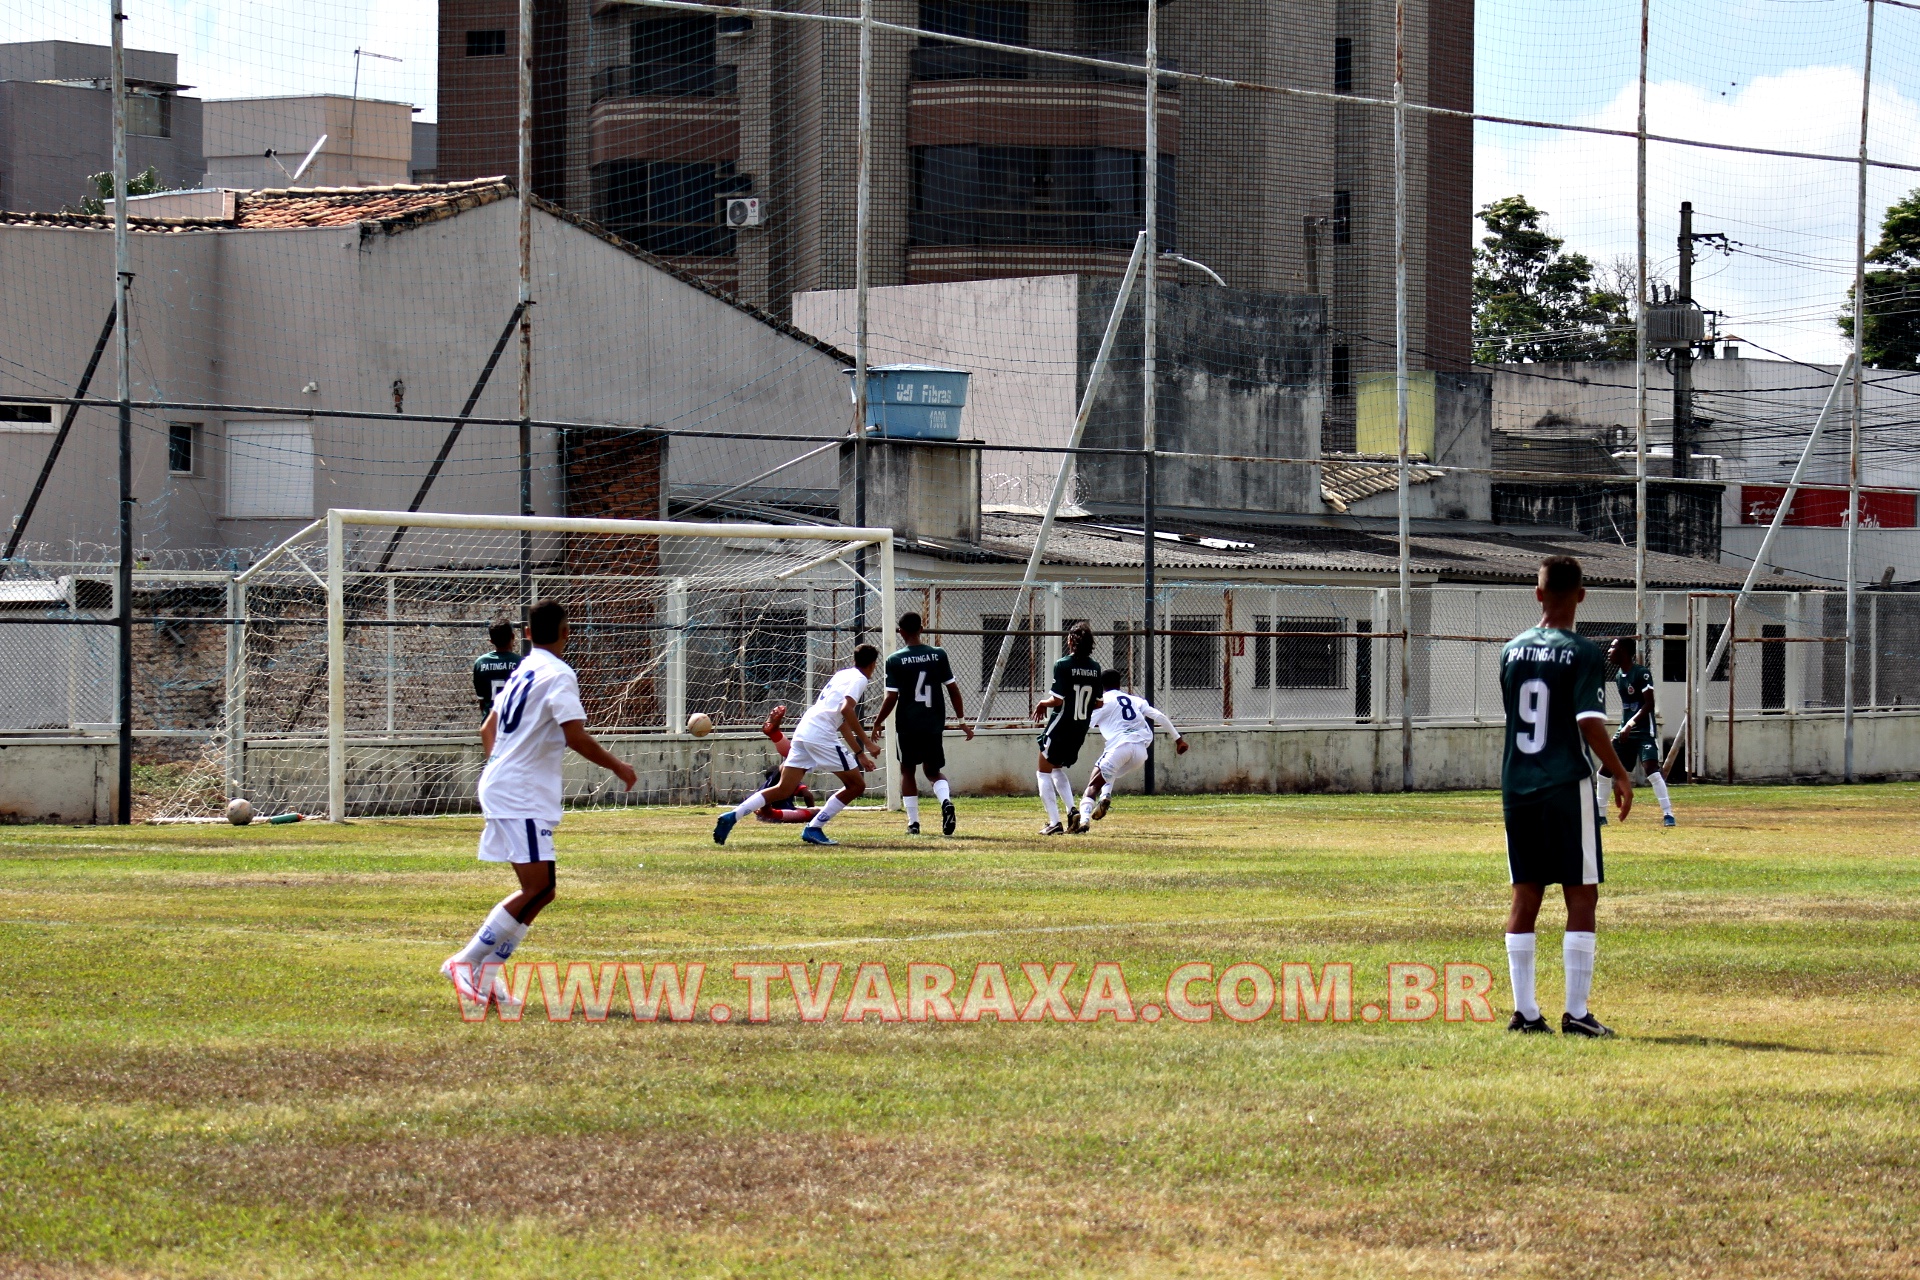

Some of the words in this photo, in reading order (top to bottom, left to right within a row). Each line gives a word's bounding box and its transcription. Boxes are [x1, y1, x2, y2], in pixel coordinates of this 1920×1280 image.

[921, 384, 952, 404] Fibras
[480, 662, 507, 672] IPATINGA
[508, 661, 517, 670] FC
[901, 655, 930, 665] IPATINGA
[931, 653, 939, 661] FC
[1506, 646, 1556, 665] IPATINGA
[1559, 649, 1574, 665] FC
[915, 670, 932, 708] 4
[1073, 684, 1093, 721] 10
[1116, 695, 1137, 721] 8
[1516, 678, 1550, 754] 9
